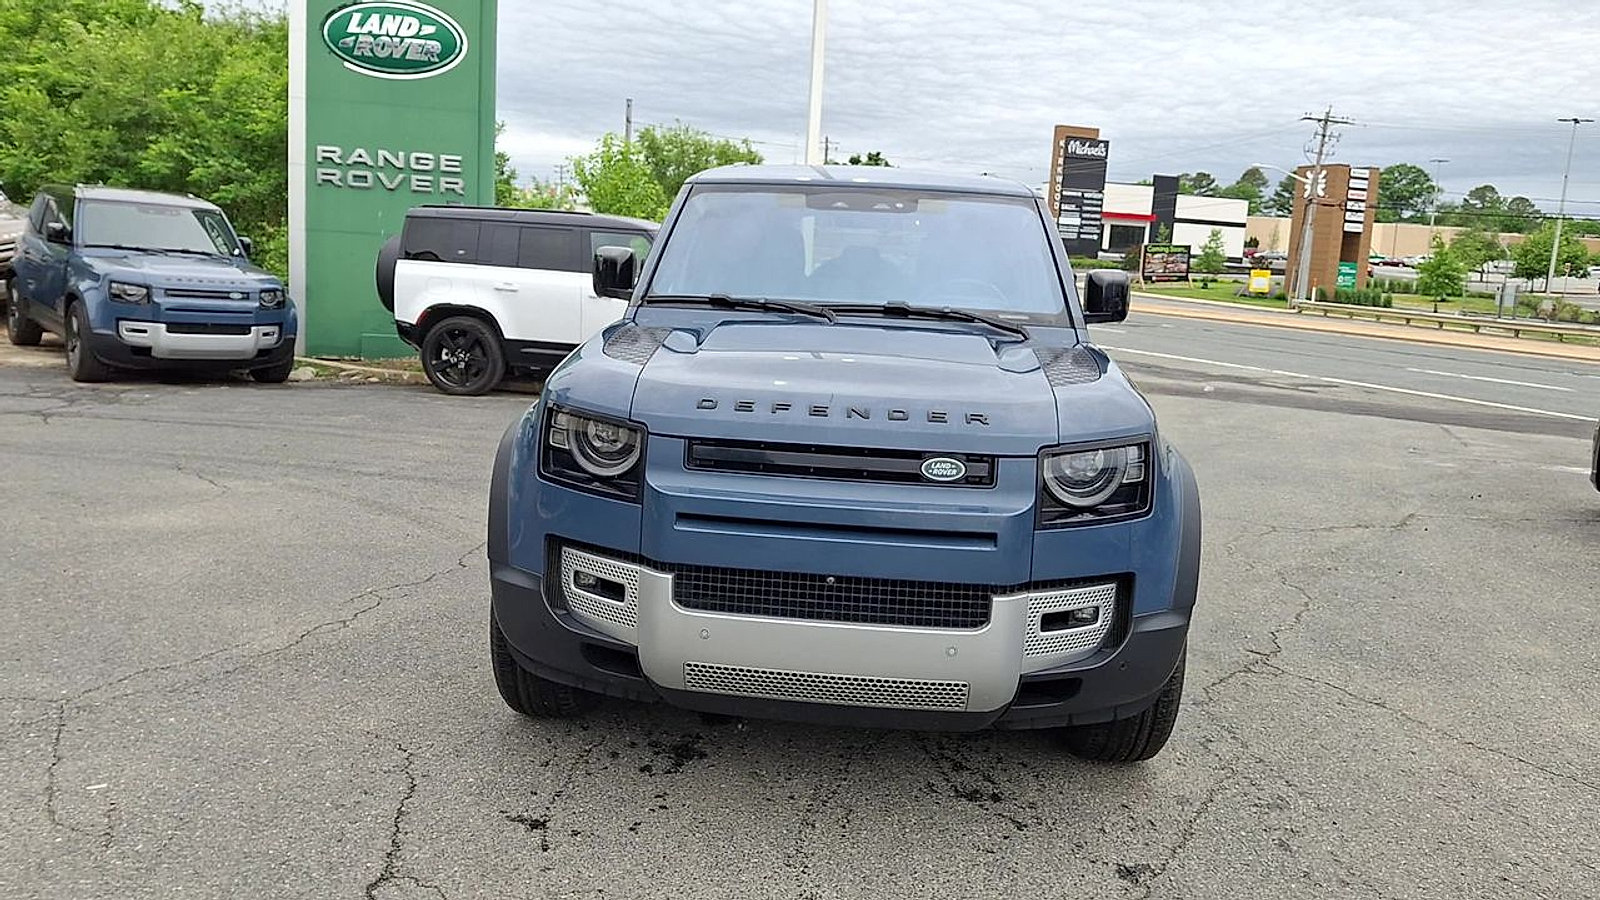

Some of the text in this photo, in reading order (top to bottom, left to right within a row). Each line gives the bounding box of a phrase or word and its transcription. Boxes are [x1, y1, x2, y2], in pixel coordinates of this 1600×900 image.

[347, 12, 420, 37] LAND
[353, 35, 442, 62] ROVER
[316, 145, 463, 173] RANGE
[316, 168, 465, 196] ROVER
[696, 397, 991, 427] DEFENDER
[932, 468, 958, 476] ROVER
